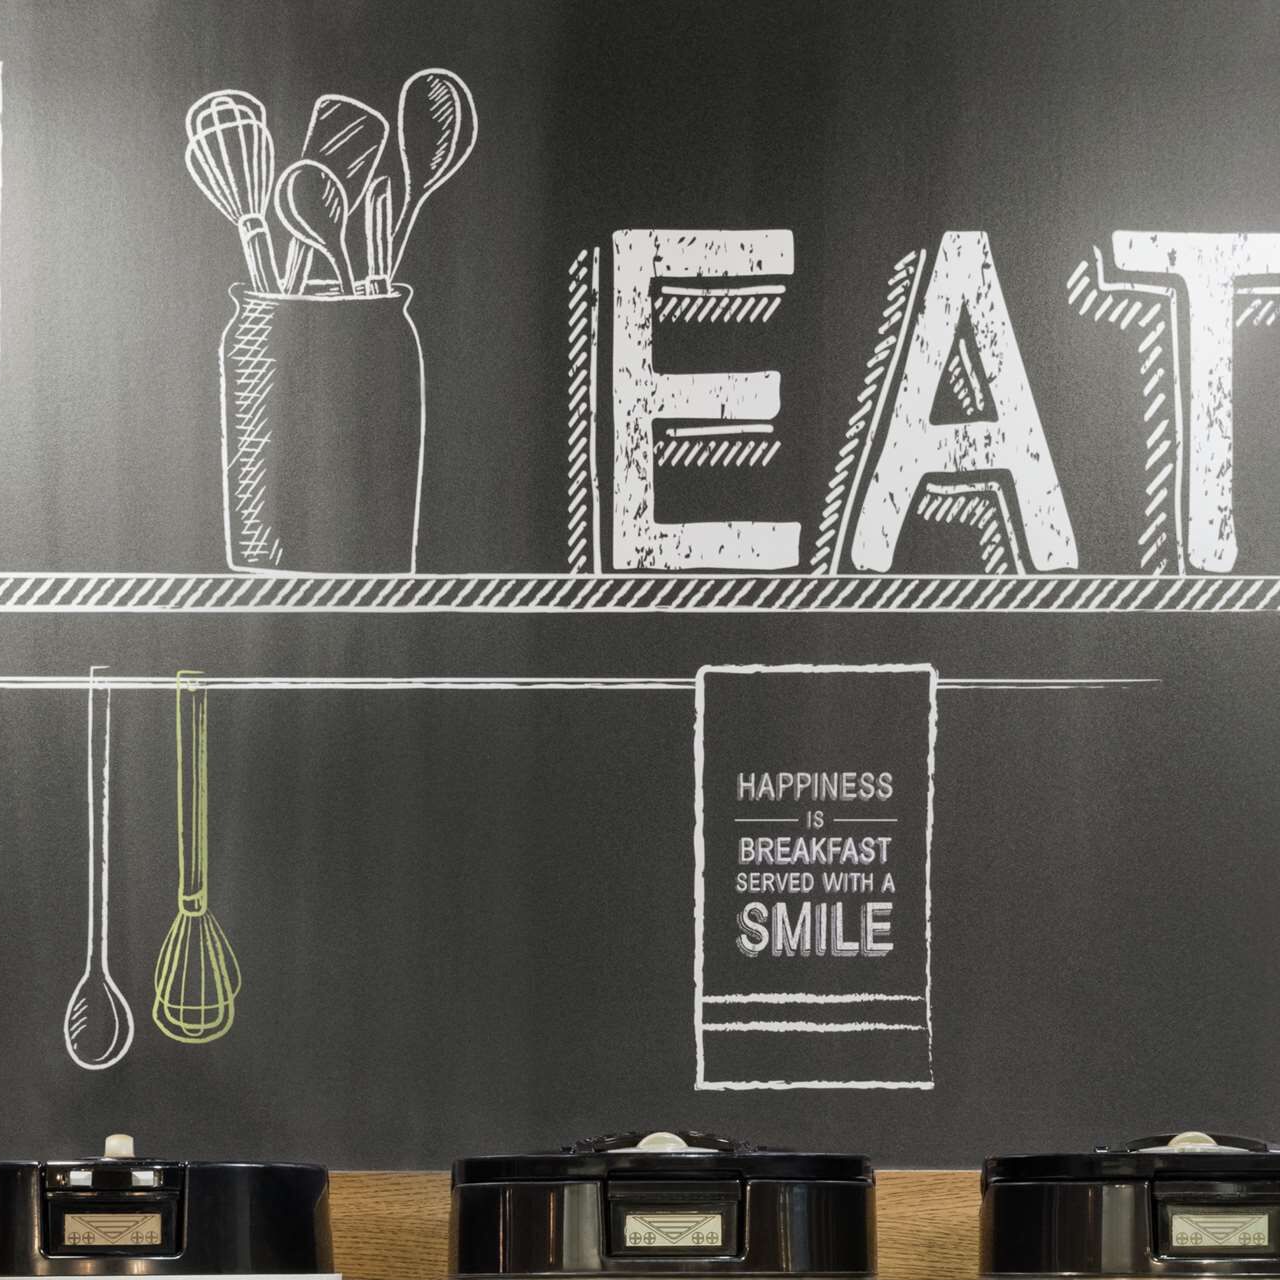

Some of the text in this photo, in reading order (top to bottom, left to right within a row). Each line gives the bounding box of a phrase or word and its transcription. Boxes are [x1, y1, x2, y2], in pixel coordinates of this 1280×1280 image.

[737, 772, 894, 801] HAPPINESS
[805, 811, 825, 829] IS
[738, 837, 892, 865] BREAKFAST
[735, 871, 896, 894] SERVED WITH A
[736, 901, 894, 957] SMILE
